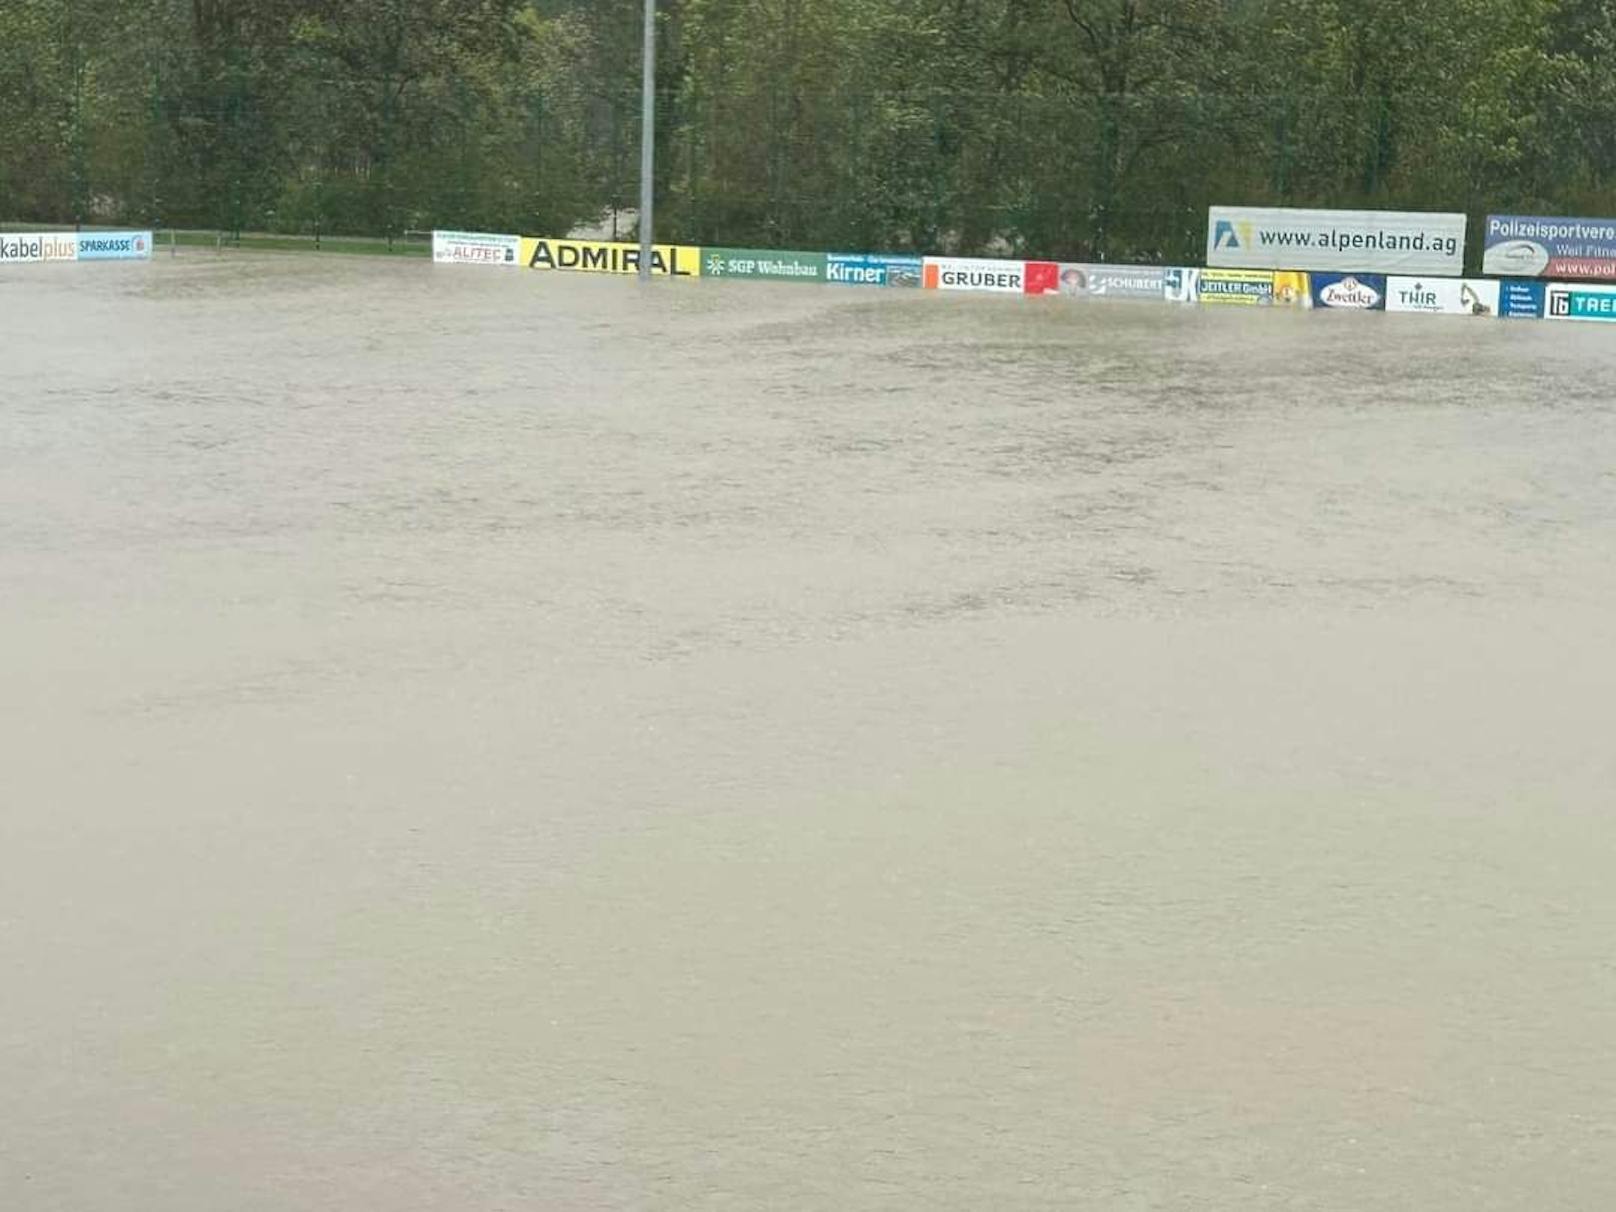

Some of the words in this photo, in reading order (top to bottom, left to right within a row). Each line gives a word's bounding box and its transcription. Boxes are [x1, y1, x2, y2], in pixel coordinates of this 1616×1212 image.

[1490, 220, 1616, 240] Polizeisportvere
[0, 237, 75, 263] kabelplus
[80, 240, 131, 252] SPARKASSE
[1260, 229, 1457, 255] www.alpenland.ag
[529, 241, 691, 275] ADMIRAL
[728, 259, 755, 273] SGP
[757, 260, 818, 276] Wohnbau
[826, 262, 885, 282] Kirner
[942, 271, 1021, 288] GRUBER
[1326, 287, 1372, 305] Zwettler
